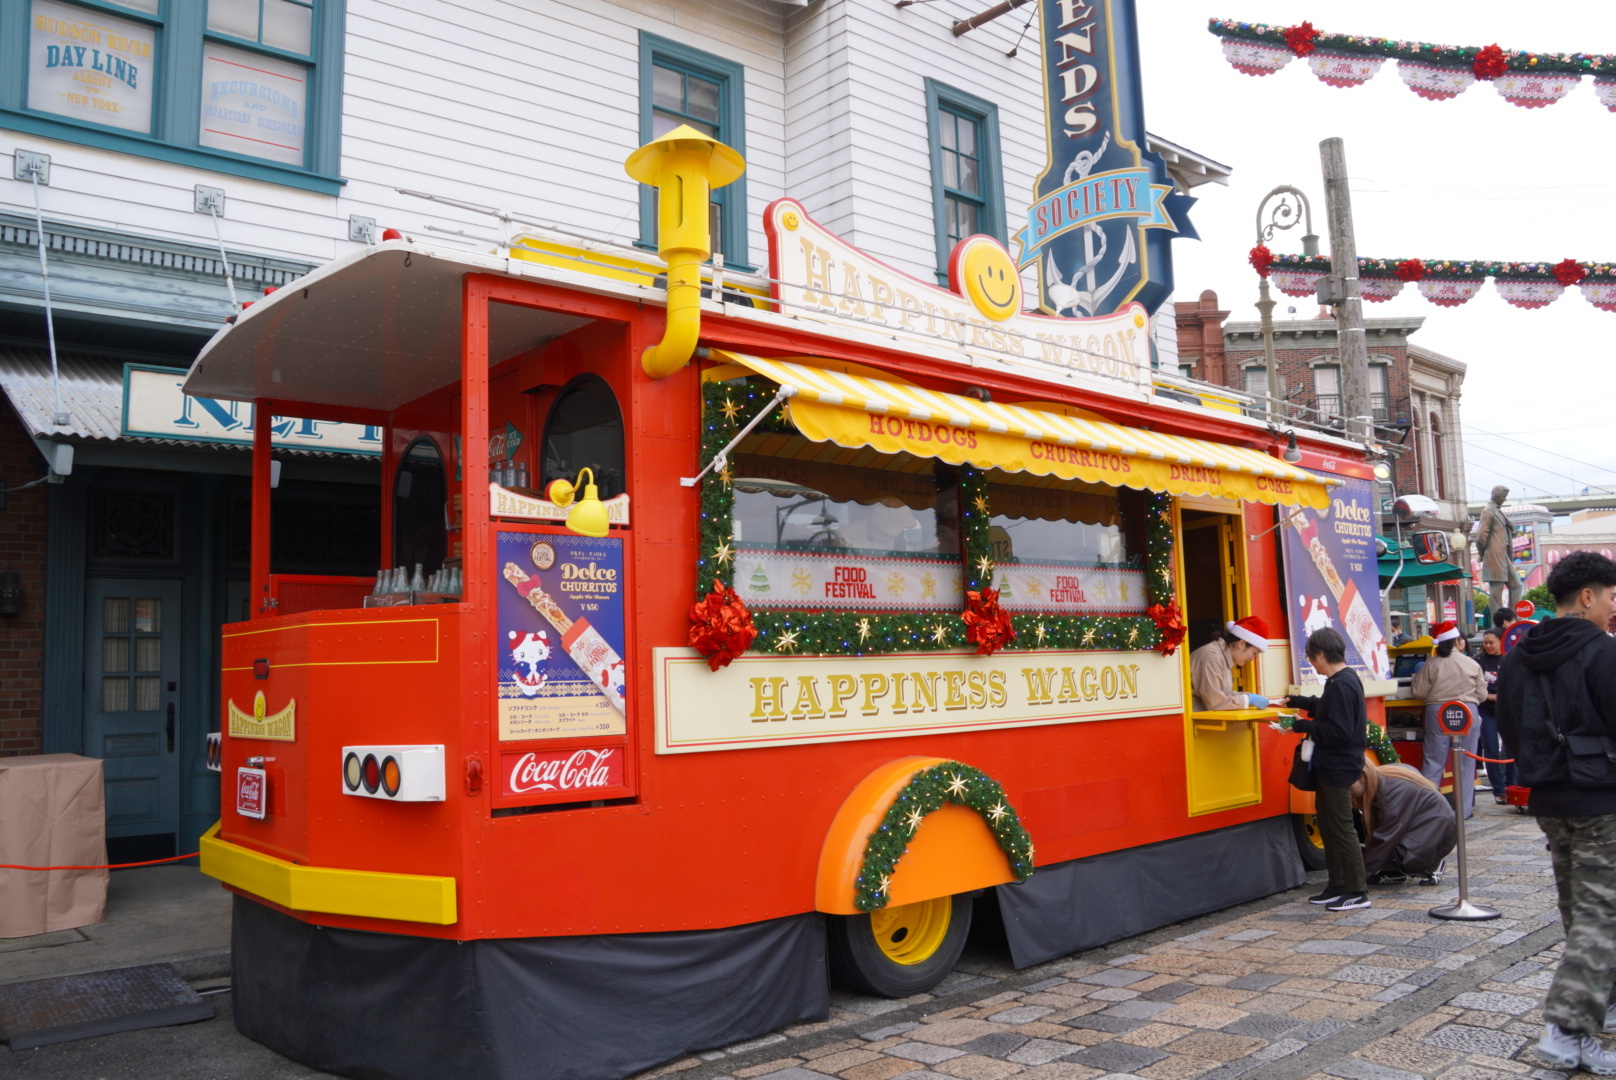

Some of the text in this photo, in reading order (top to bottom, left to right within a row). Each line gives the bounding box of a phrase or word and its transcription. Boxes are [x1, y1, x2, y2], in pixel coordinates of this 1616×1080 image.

[35, 14, 151, 58] HUDSON RIVER
[46, 45, 137, 90] DAY LINE
[73, 70, 113, 88] ALBANY
[85, 86, 101, 94] TO
[209, 81, 298, 118] EXCURSIONS
[67, 92, 119, 112] NEW YORK
[204, 104, 251, 125] DEPARTURES
[1037, 177, 1139, 237] SOCIETY
[800, 236, 1138, 379] HAPPINESS WAGON
[868, 412, 1293, 494] HOTDOGS CHURRITOS DRINKS COKE
[496, 491, 572, 517] HAPPINESS
[1333, 498, 1370, 522] Dolce
[1334, 521, 1372, 537] CHURRITOS
[560, 562, 617, 580] Dolce
[834, 566, 867, 582] FOOD
[560, 581, 618, 593] CHURRITOS
[825, 582, 876, 599] FESTIVAL
[1056, 575, 1079, 589] FOOD
[1050, 589, 1087, 603] FESTIVAL
[749, 664, 1139, 723] HAPPINESS WAGON
[231, 710, 292, 737] HAPPINESS WAGON
[1446, 709, 1463, 719] 出口
[509, 748, 615, 793] Coca-Cola
